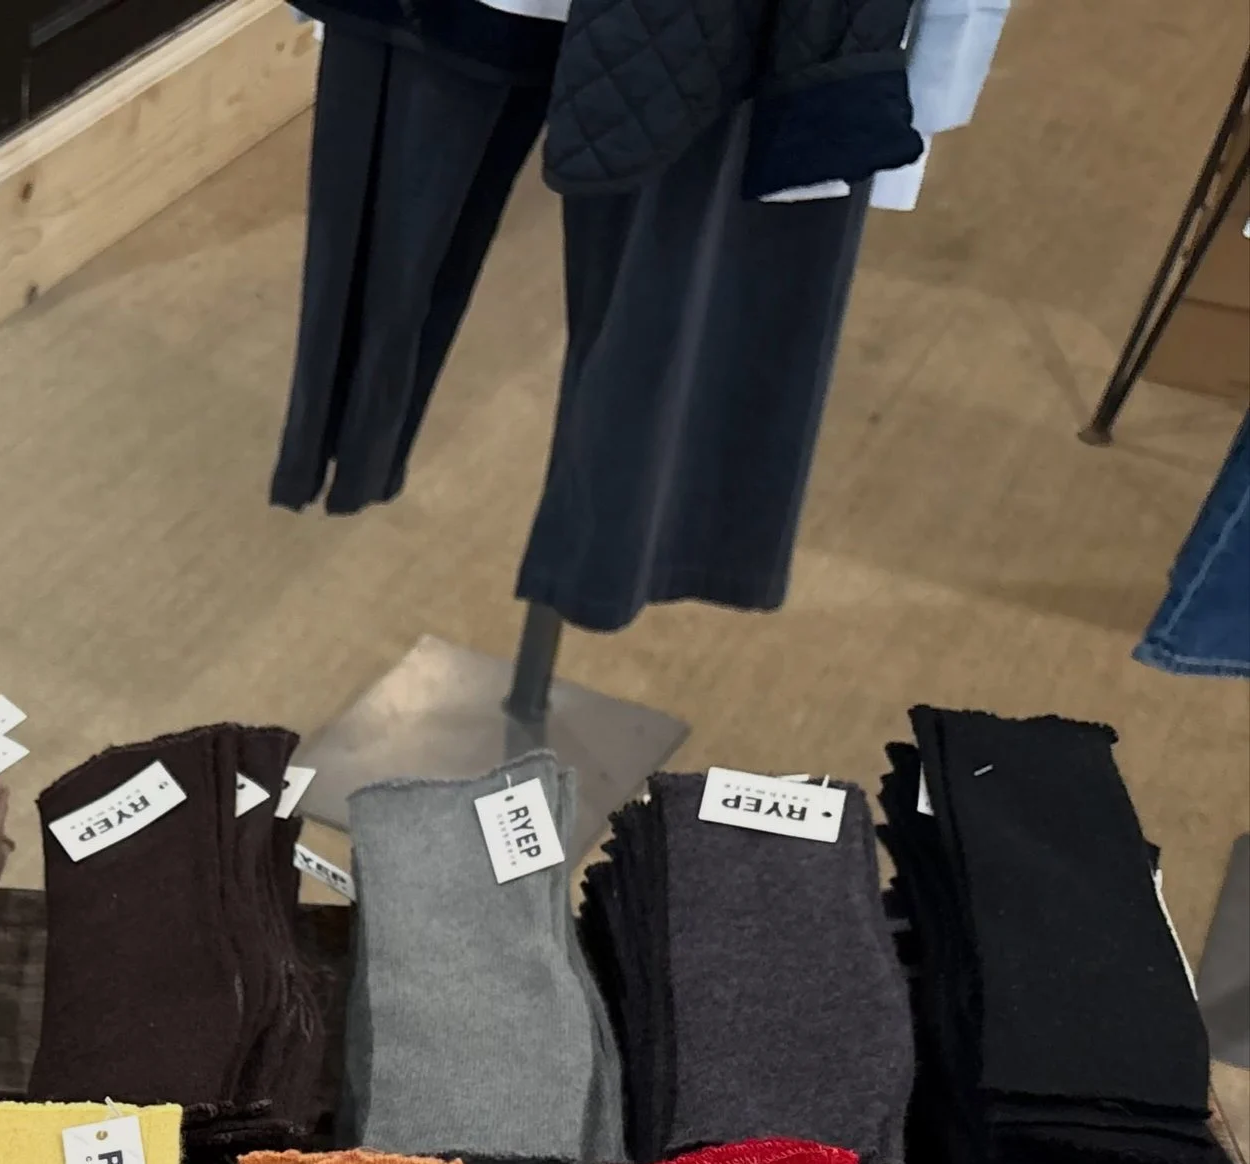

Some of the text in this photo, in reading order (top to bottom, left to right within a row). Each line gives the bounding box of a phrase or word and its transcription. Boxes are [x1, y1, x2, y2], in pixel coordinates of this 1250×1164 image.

[78, 795, 151, 842] RYEP
[507, 805, 542, 858] RYEP
[721, 795, 808, 821] RYEP
